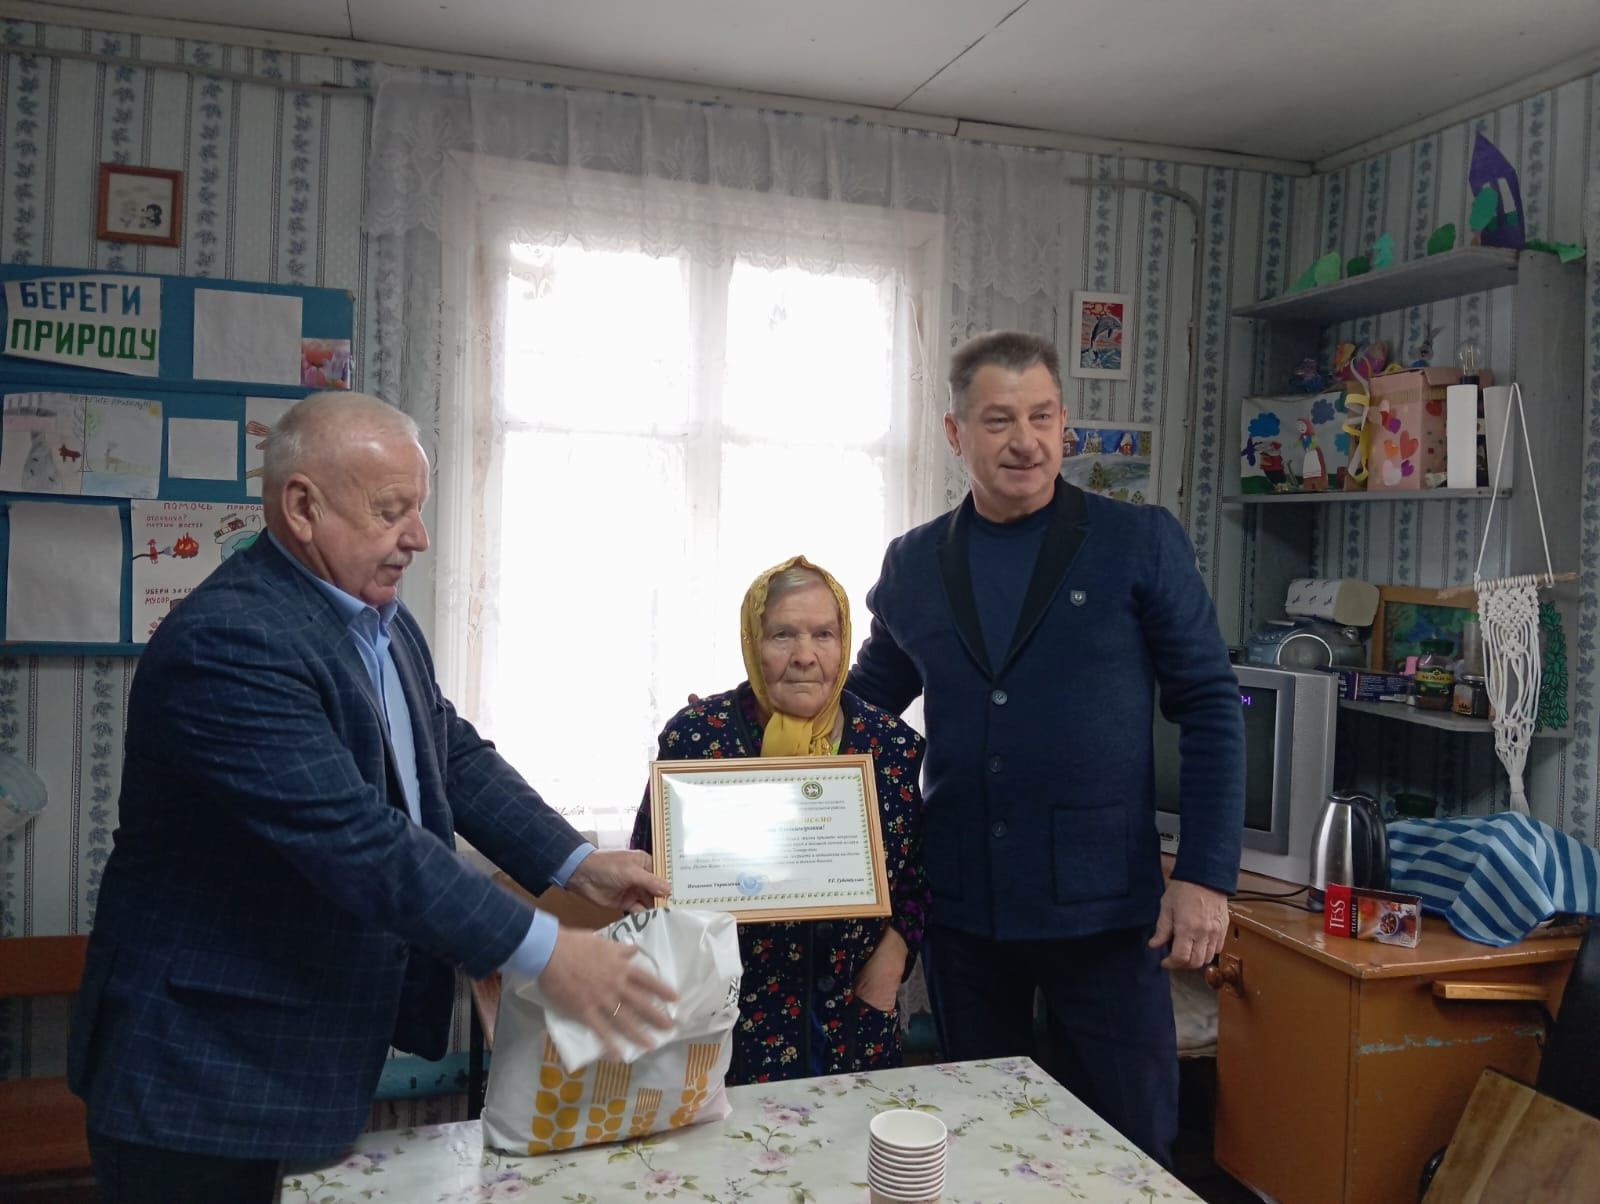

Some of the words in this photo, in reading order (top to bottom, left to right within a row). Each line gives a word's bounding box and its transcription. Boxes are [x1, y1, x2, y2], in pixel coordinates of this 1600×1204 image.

[20, 281, 142, 315] БЕРЕГИ
[11, 318, 157, 361] ПРИРОДУ
[227, 504, 263, 512] ПРИРОД
[144, 596, 170, 605] МУСОР
[1329, 900, 1346, 929] TESS
